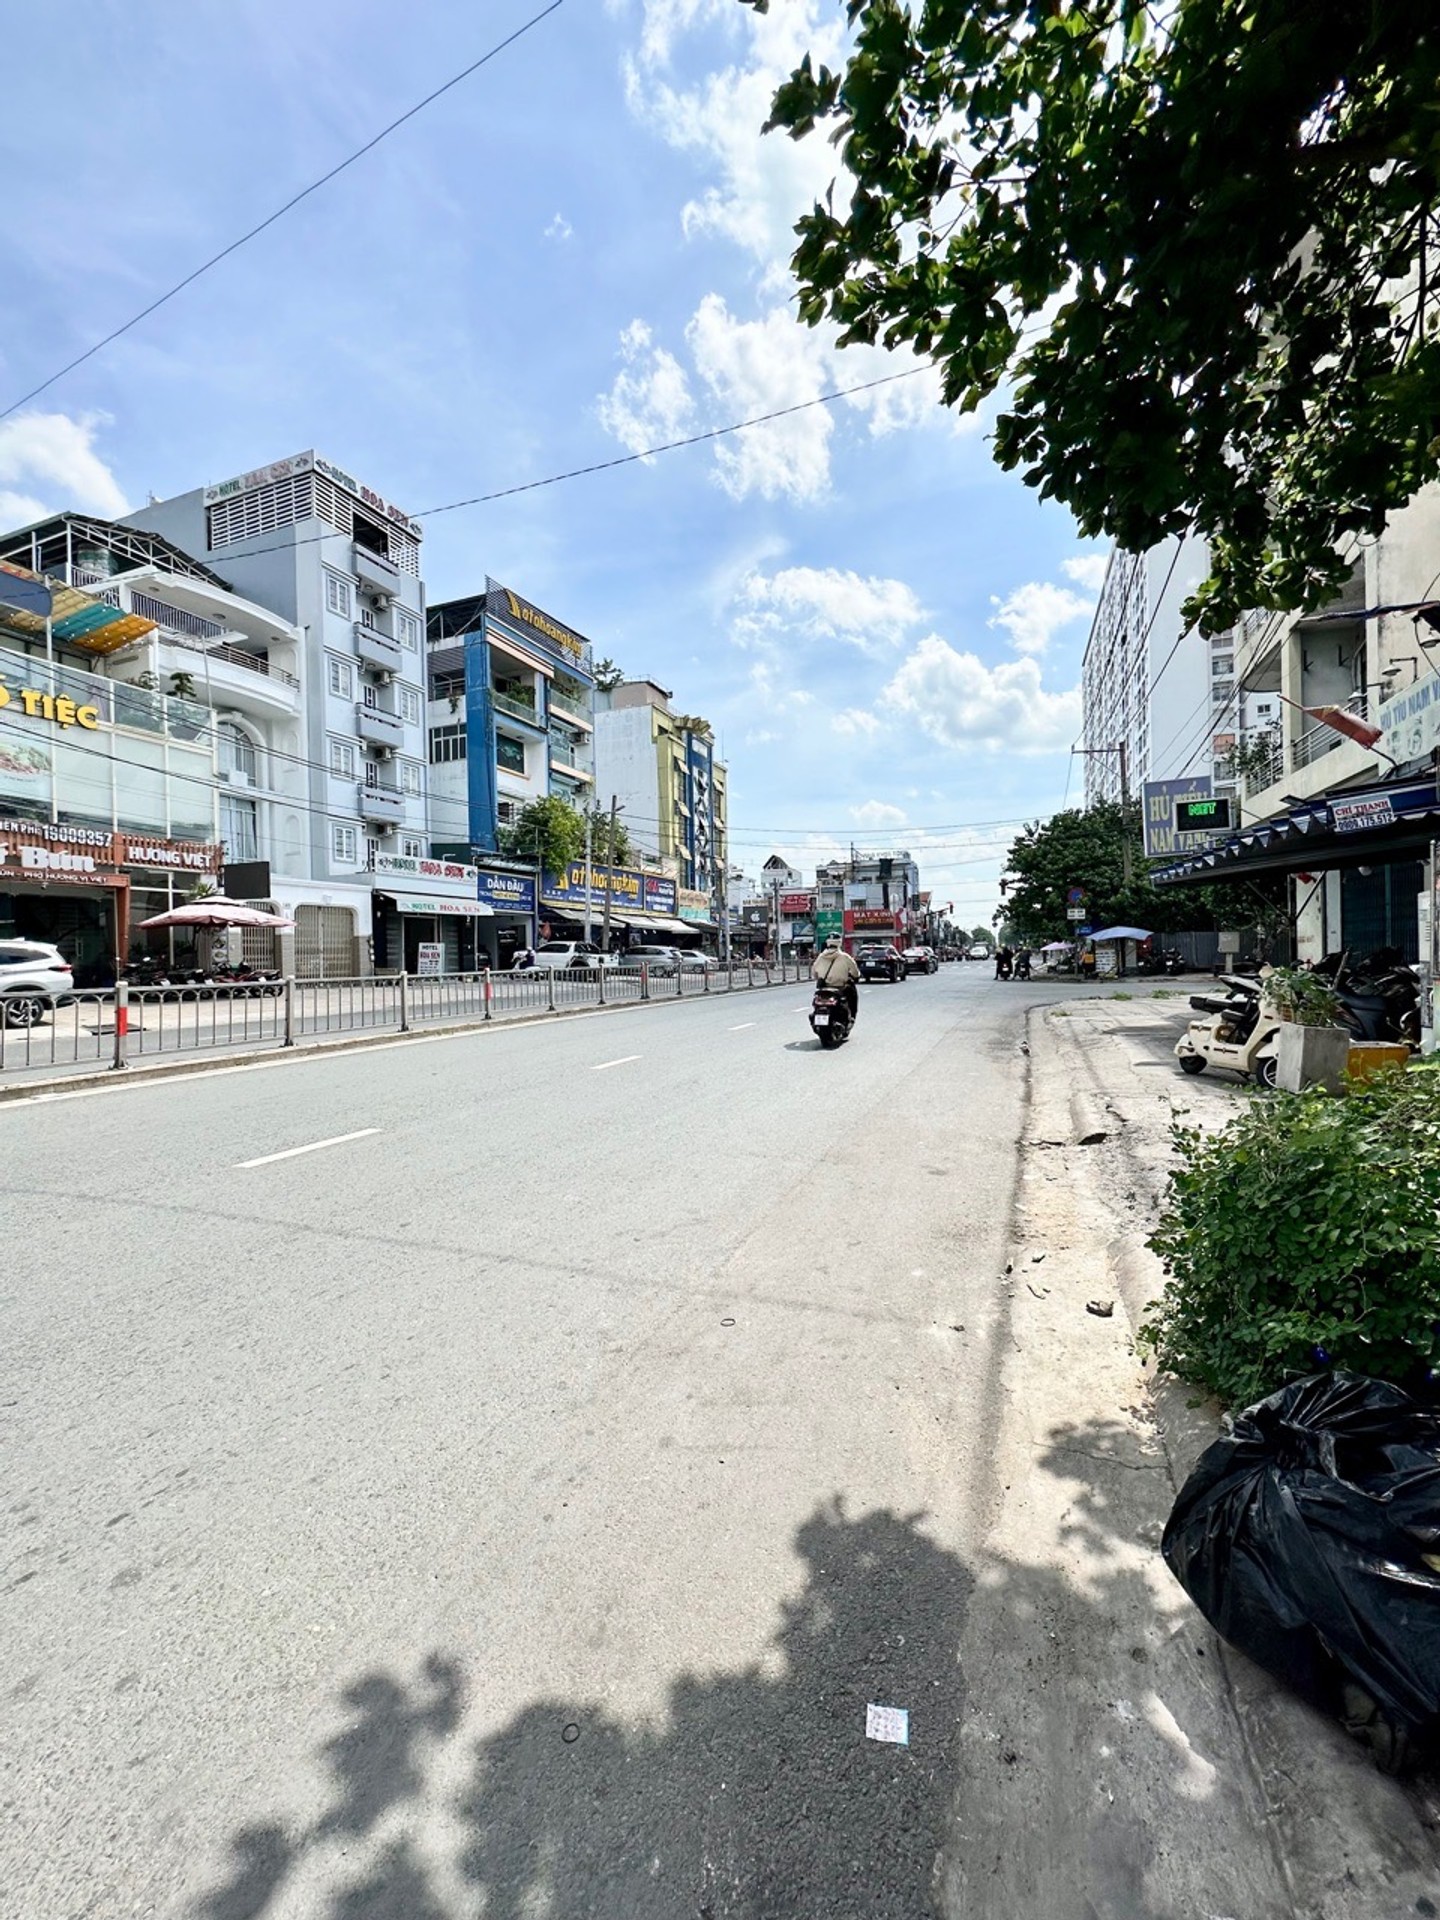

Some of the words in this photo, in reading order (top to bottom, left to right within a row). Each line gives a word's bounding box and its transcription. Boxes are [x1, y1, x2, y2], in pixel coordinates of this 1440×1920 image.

[21, 688, 98, 730] TIỆC
[1149, 785, 1170, 822] HỦ
[440, 904, 460, 912] HOA
[463, 905, 480, 913] SEN
